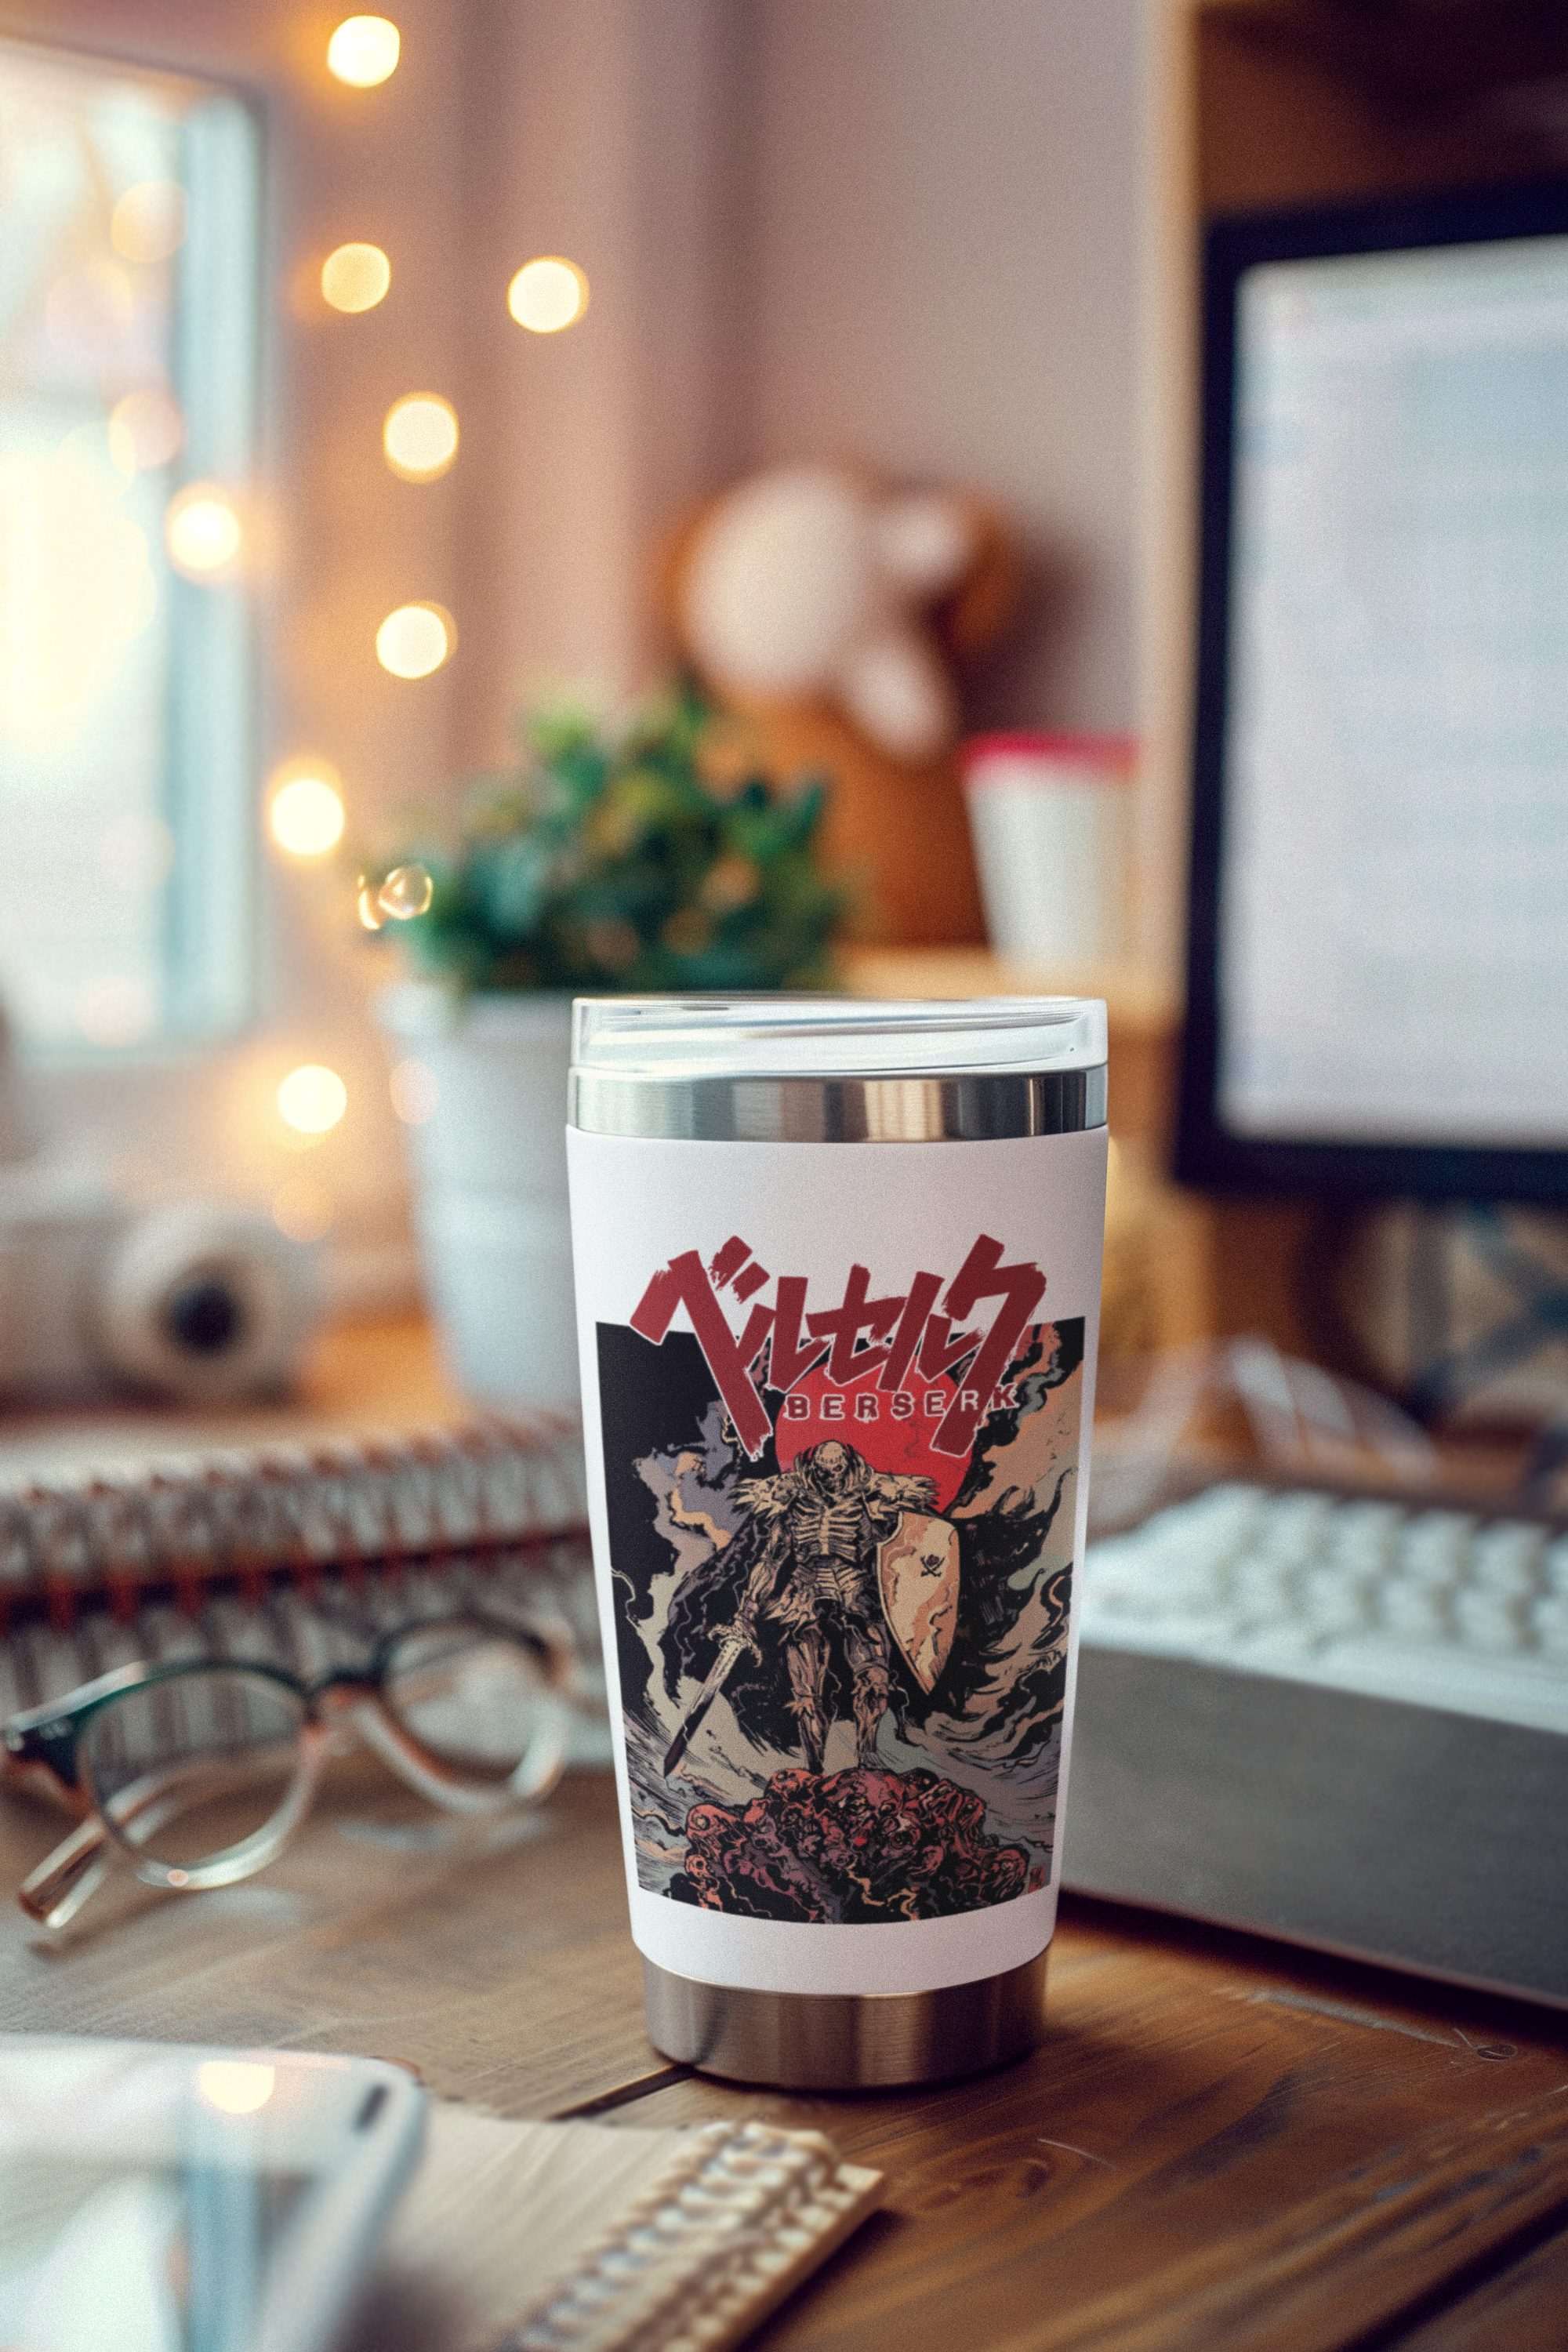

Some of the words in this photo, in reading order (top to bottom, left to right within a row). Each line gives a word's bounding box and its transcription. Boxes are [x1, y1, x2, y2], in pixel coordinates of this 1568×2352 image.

[629, 1234, 1047, 1461] ベルセルク
[783, 1382, 1020, 1422] BERSERK
